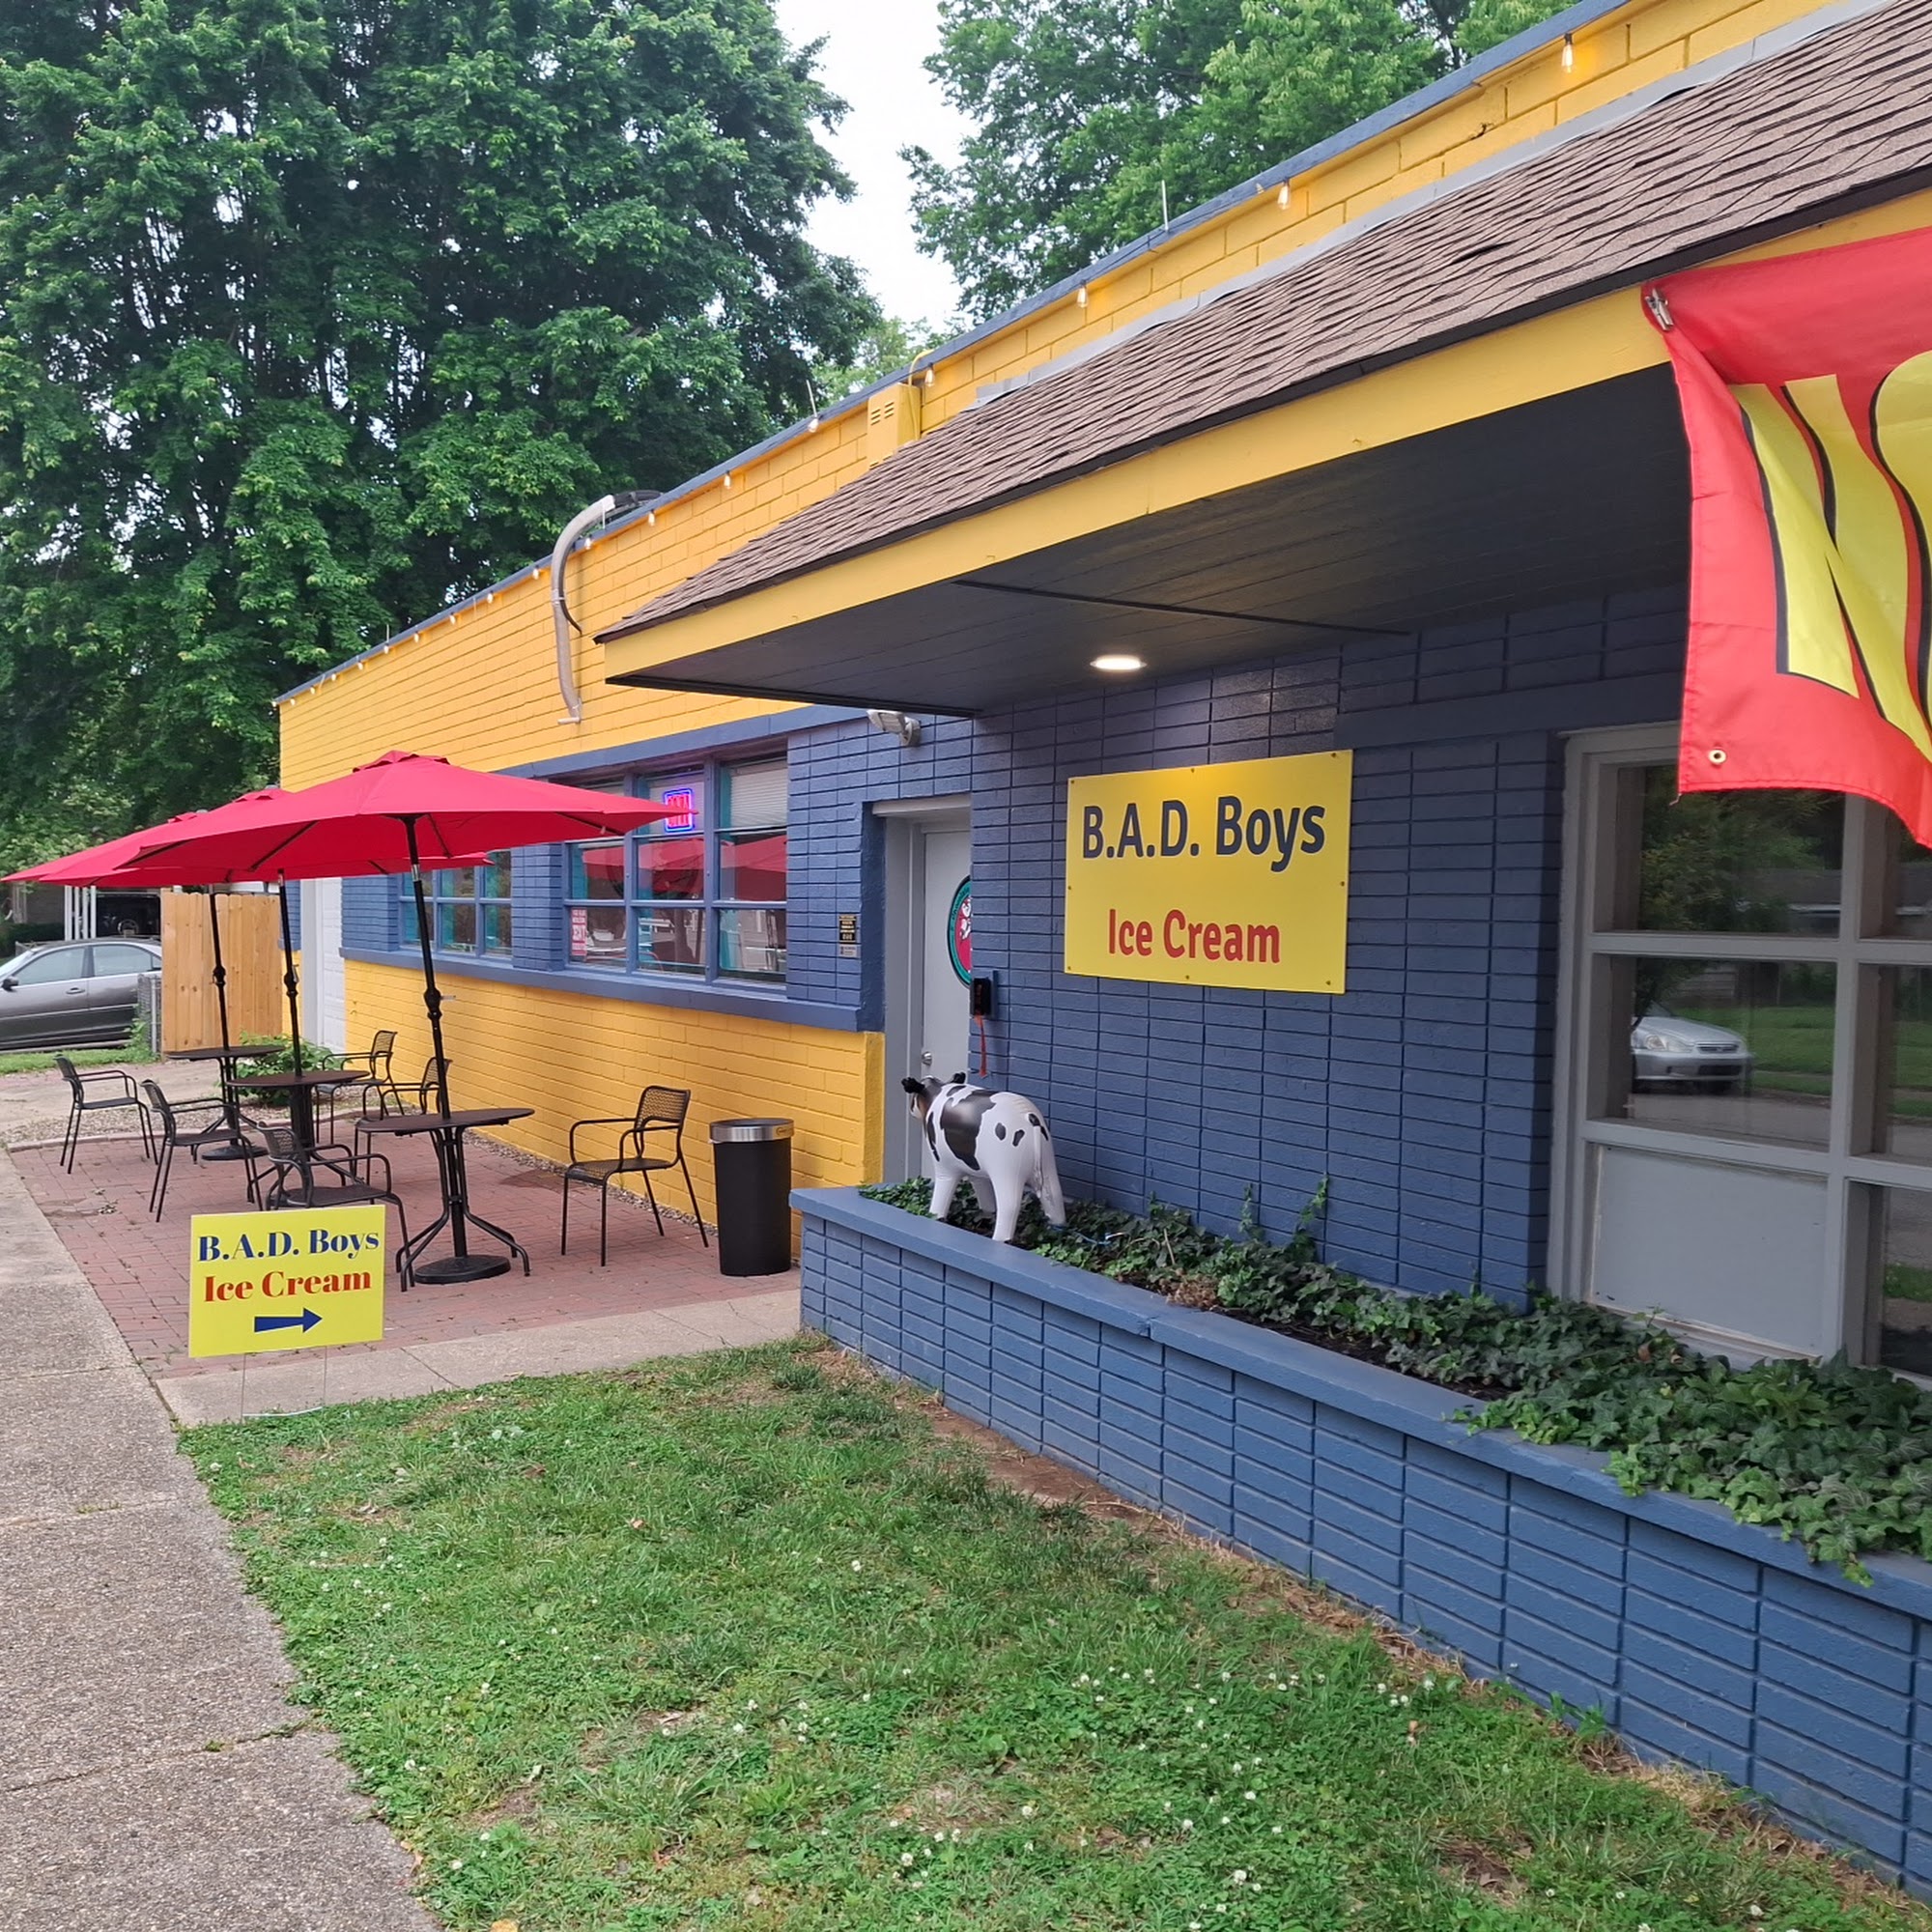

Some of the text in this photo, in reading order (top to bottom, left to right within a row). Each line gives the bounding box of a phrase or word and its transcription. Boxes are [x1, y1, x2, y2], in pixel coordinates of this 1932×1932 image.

[1082, 795, 1326, 873] B.A.D. Boys
[1109, 908, 1281, 964] Ice Cream
[197, 1228, 380, 1263] B.A.D. Boys
[203, 1270, 372, 1302] Ice Cream
